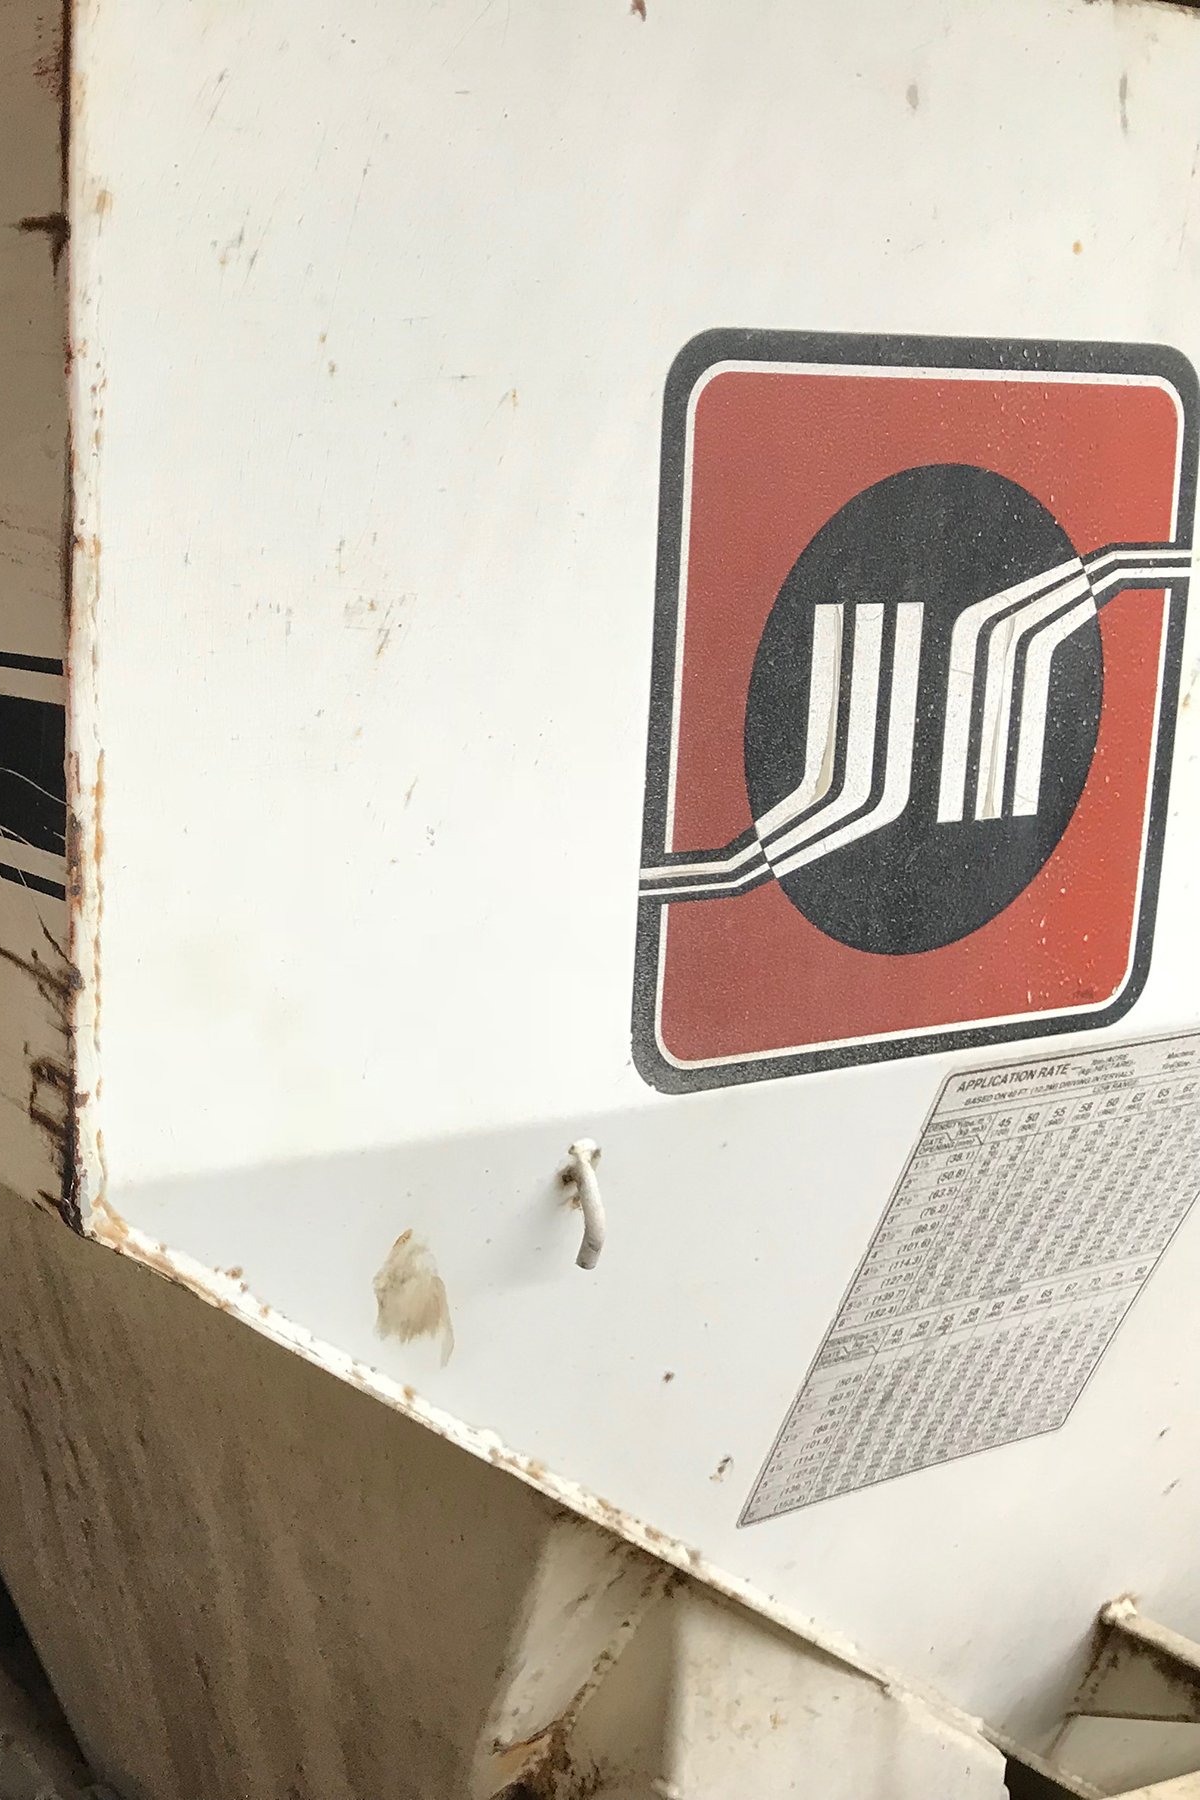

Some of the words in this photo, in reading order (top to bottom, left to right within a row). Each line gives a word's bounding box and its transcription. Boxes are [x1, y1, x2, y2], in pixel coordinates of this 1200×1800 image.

[957, 1069, 1037, 1092] APPLICATION
[1037, 1063, 1071, 1078] RATE
[994, 1092, 1007, 1100] ON
[998, 1117, 1013, 1128] 45
[1025, 1112, 1040, 1123] 50
[1052, 1106, 1067, 1118] 55
[1078, 1101, 1094, 1113] 58
[1105, 1097, 1120, 1108] 60
[1157, 1087, 1171, 1098] 65
[945, 1150, 975, 1166] (38.1)
[936, 1168, 966, 1184] (50.8)
[919, 1203, 949, 1219] (76.2)
[896, 1238, 931, 1255] (101.6)
[991, 1301, 1005, 1311] 60
